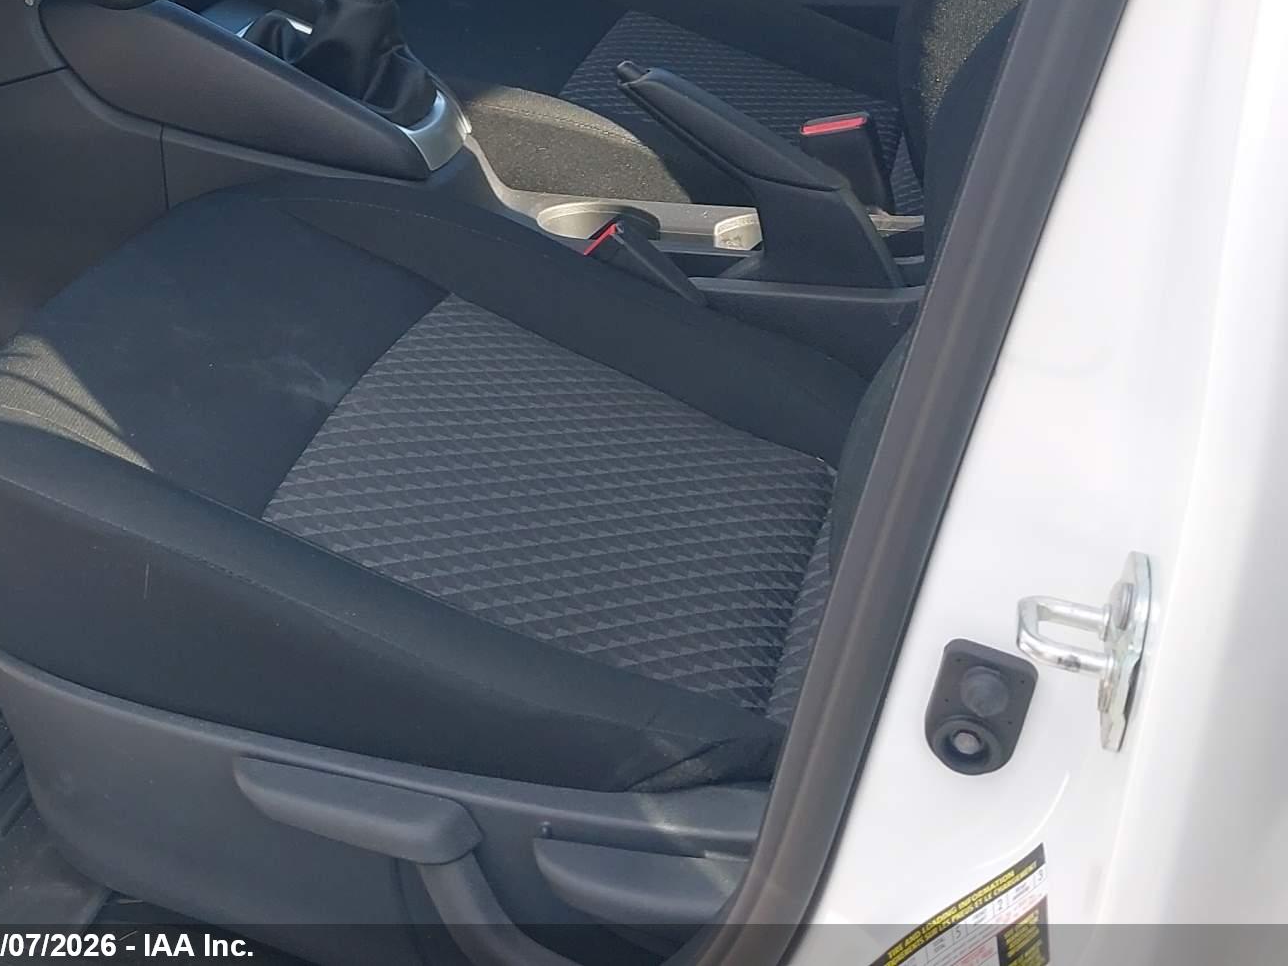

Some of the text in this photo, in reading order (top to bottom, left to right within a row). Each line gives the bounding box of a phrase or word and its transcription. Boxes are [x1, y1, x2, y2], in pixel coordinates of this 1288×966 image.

[903, 930, 921, 947] AND
[921, 906, 958, 934] LOADING
[958, 870, 1015, 910] INFORMATION
